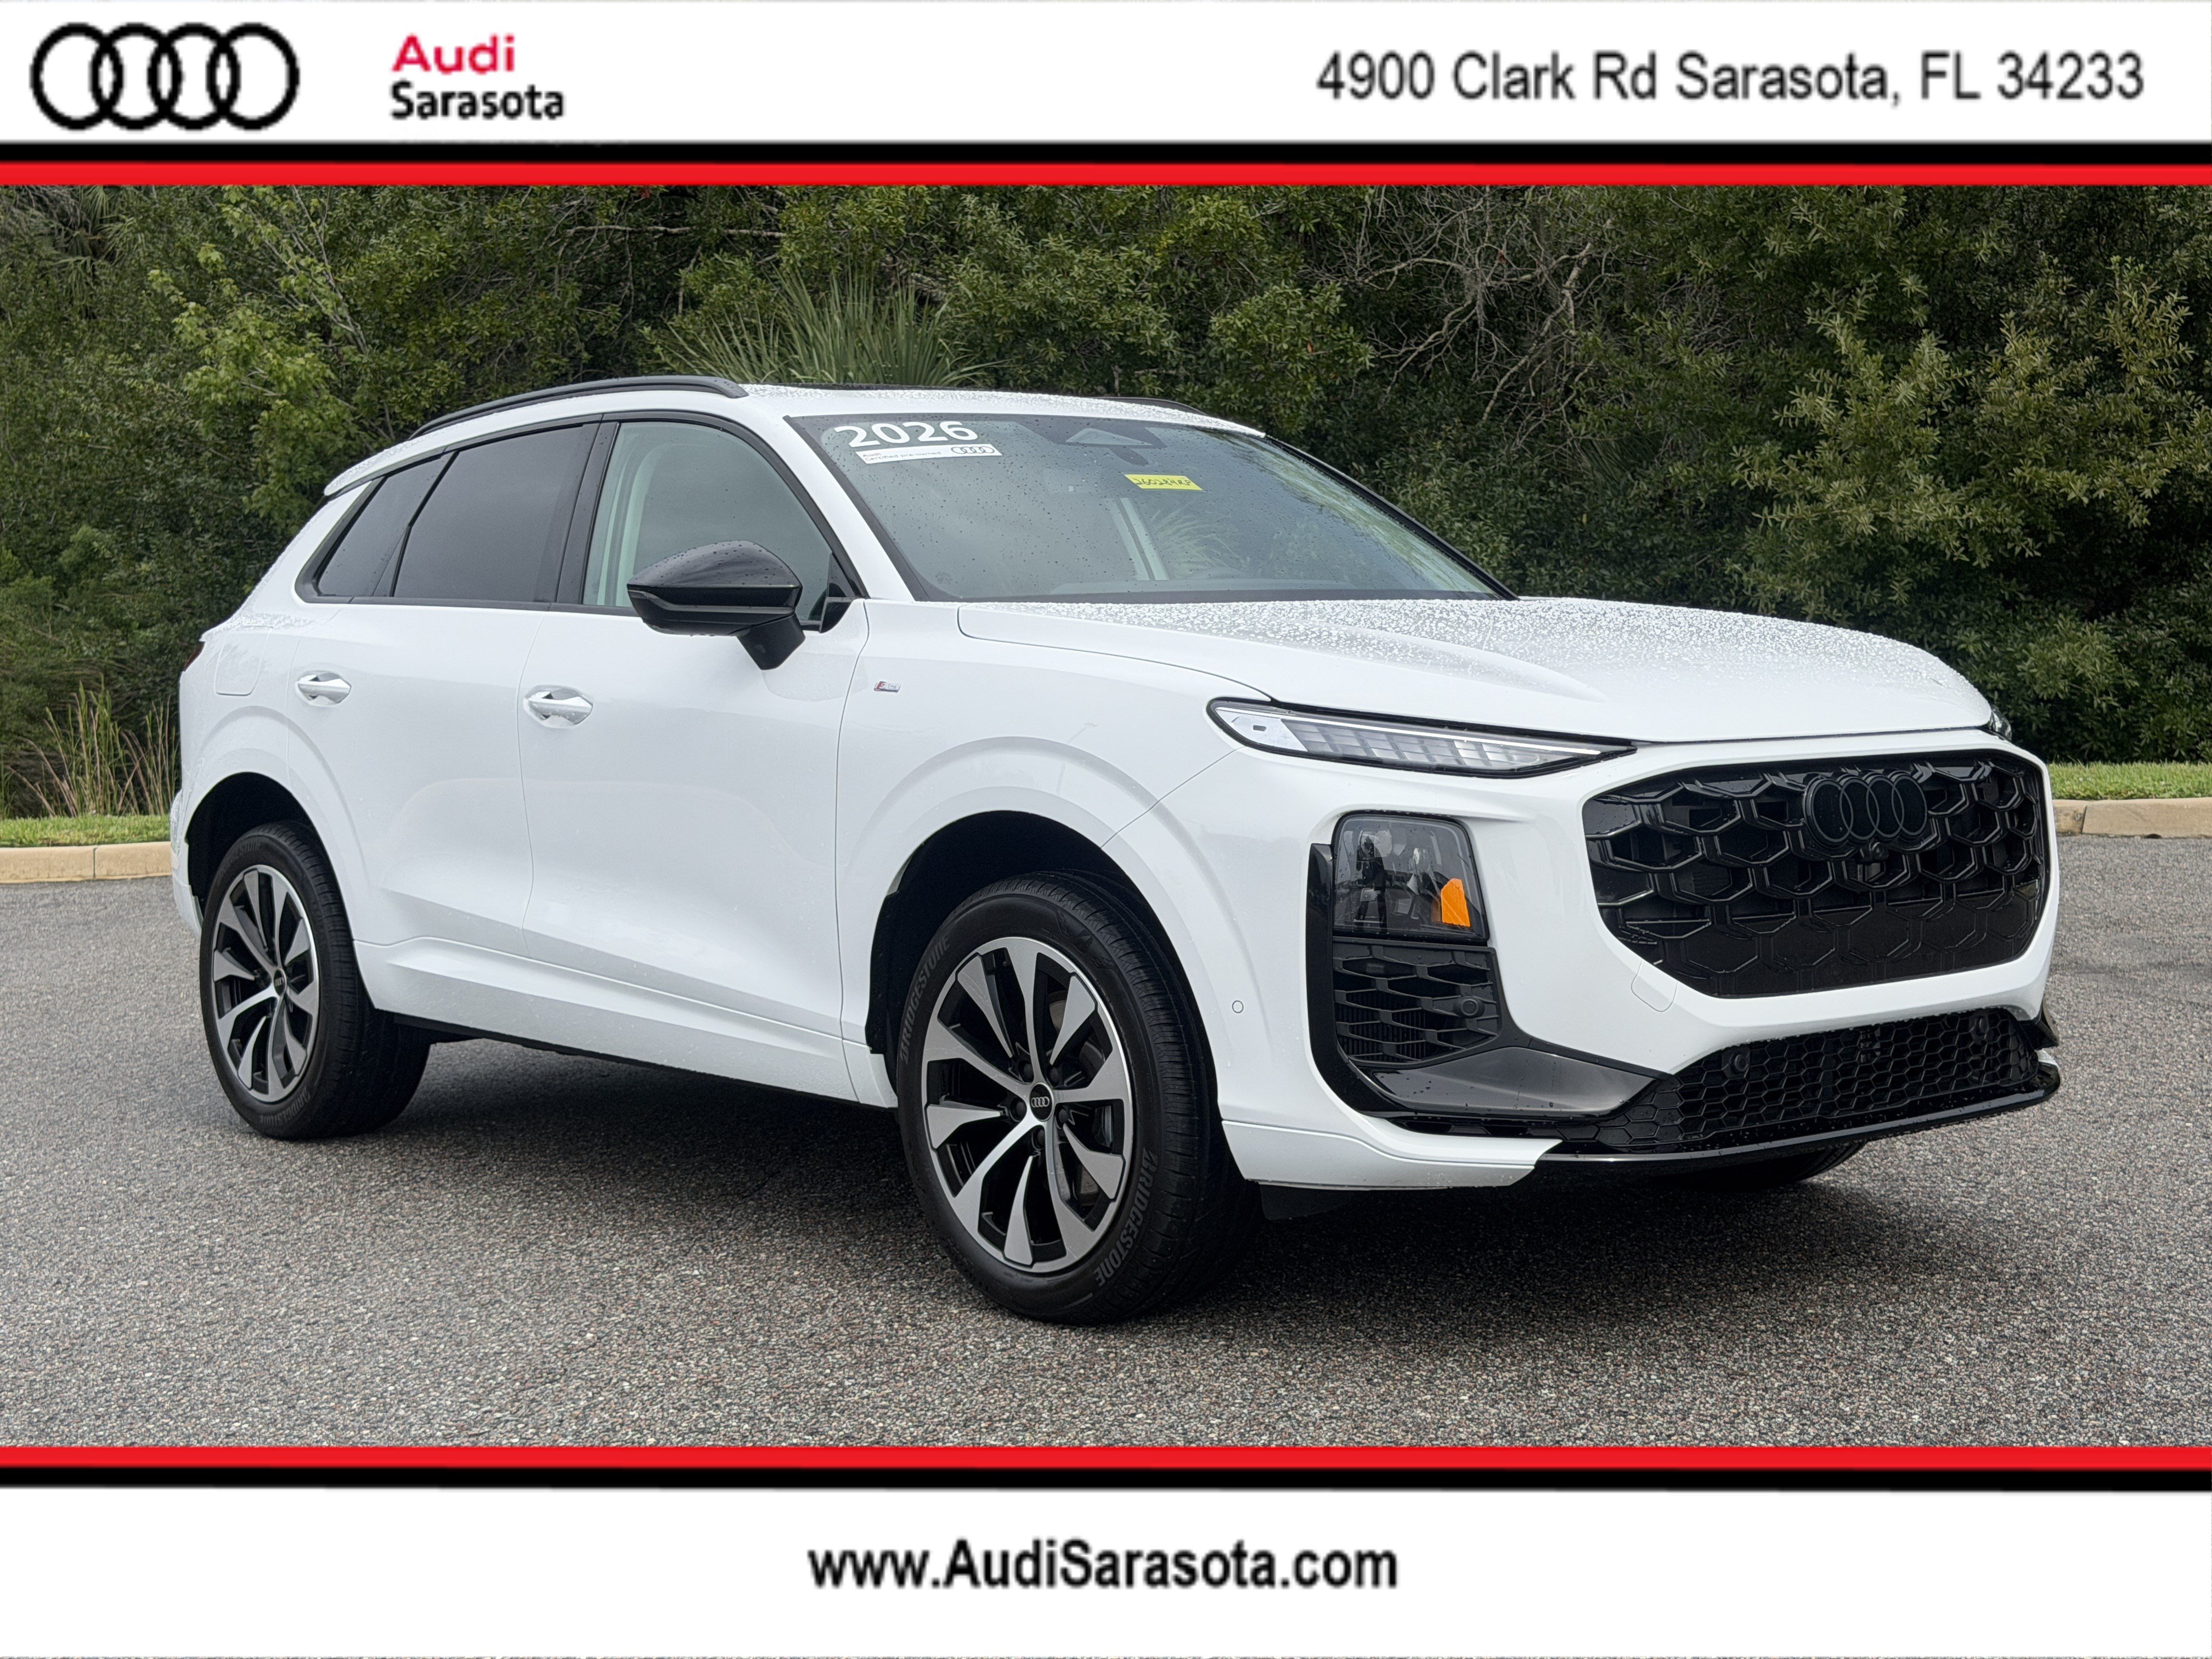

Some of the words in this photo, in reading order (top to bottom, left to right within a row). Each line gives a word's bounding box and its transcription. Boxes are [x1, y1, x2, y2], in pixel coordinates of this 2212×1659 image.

[834, 421, 978, 447] 2026
[900, 936, 950, 1065] BRIDGESTONE
[1093, 1147, 1158, 1286] BRIDGESTONE
